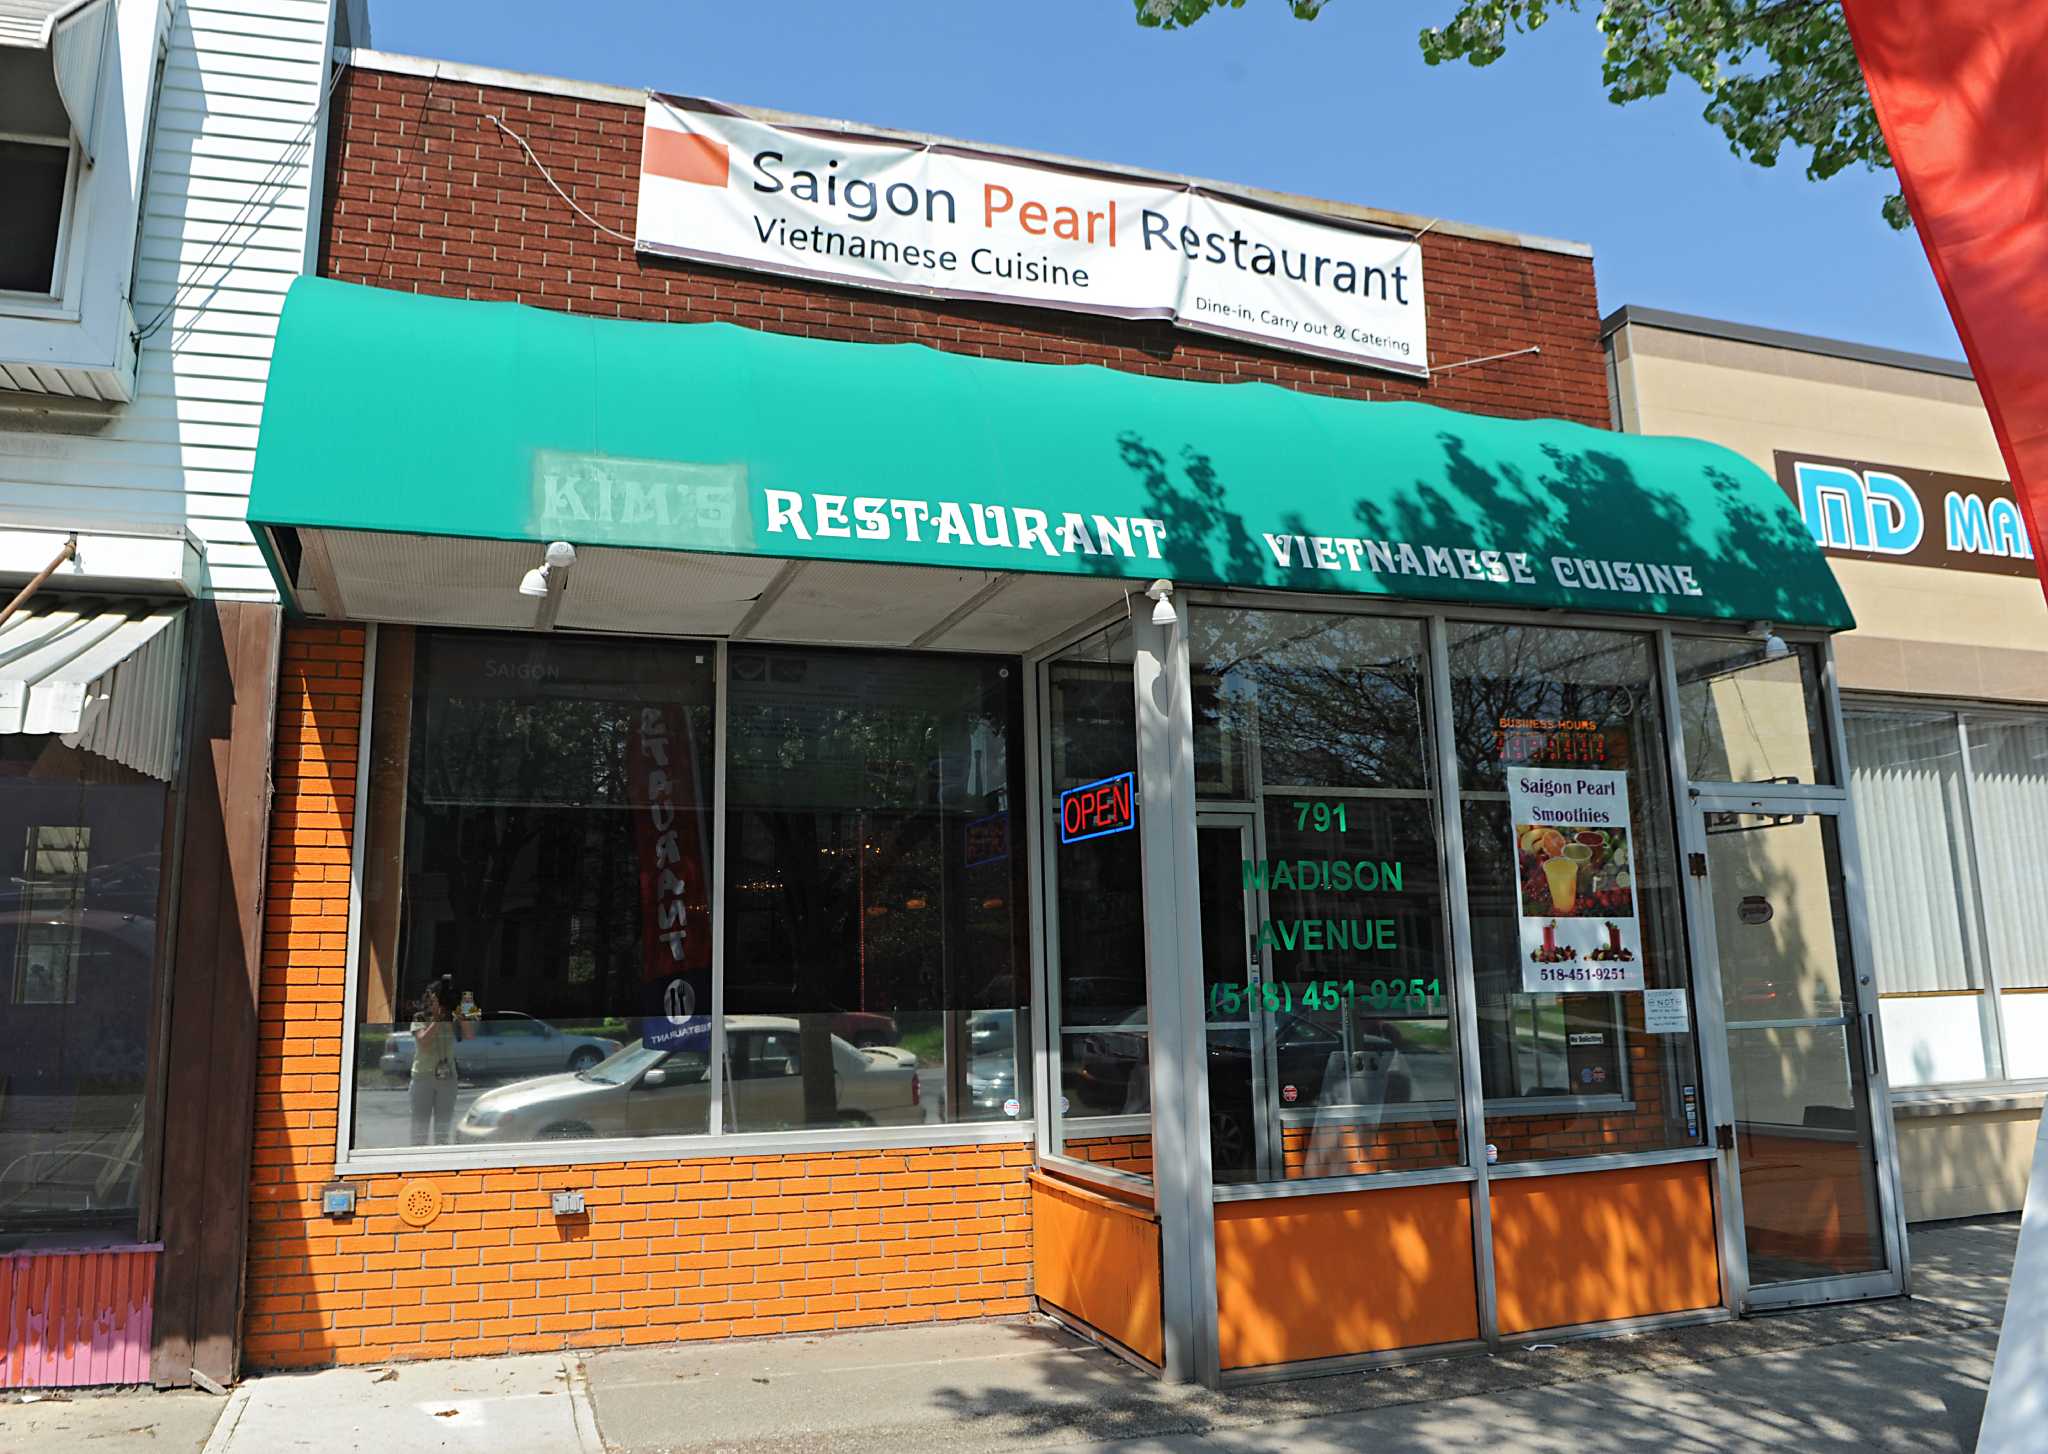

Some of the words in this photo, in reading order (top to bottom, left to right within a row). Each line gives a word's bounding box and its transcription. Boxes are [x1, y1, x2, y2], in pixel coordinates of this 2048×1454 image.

[753, 150, 956, 224] Saigon
[983, 182, 1117, 248] Pearl
[1141, 208, 1409, 306] Restaurant
[753, 215, 958, 271] Vietnamese
[970, 248, 1089, 288] Cuisine
[1196, 297, 1255, 322] Dine-in,
[1260, 310, 1299, 333] Carry
[1303, 322, 1328, 337] out
[1333, 325, 1346, 340] &
[1351, 328, 1410, 355] Catering
[1794, 460, 1925, 555] MD
[1944, 490, 2035, 560] MA
[764, 487, 1167, 559] RESTAURANT
[1263, 532, 1537, 584] VIETNAMESE
[1550, 555, 1703, 597] CUISINE
[1519, 777, 1573, 797] Saigon
[1576, 779, 1616, 796] Pearl
[1064, 782, 1131, 834] OPEN
[1293, 801, 1348, 833] 791
[1531, 806, 1610, 824] Smoothies
[1242, 859, 1404, 892] MADISON
[1256, 919, 1398, 952] AVENUE
[1540, 967, 1625, 981] 518-451-9251
[1209, 981, 1292, 1016] (518)
[1303, 978, 1442, 1013] 451-9251
